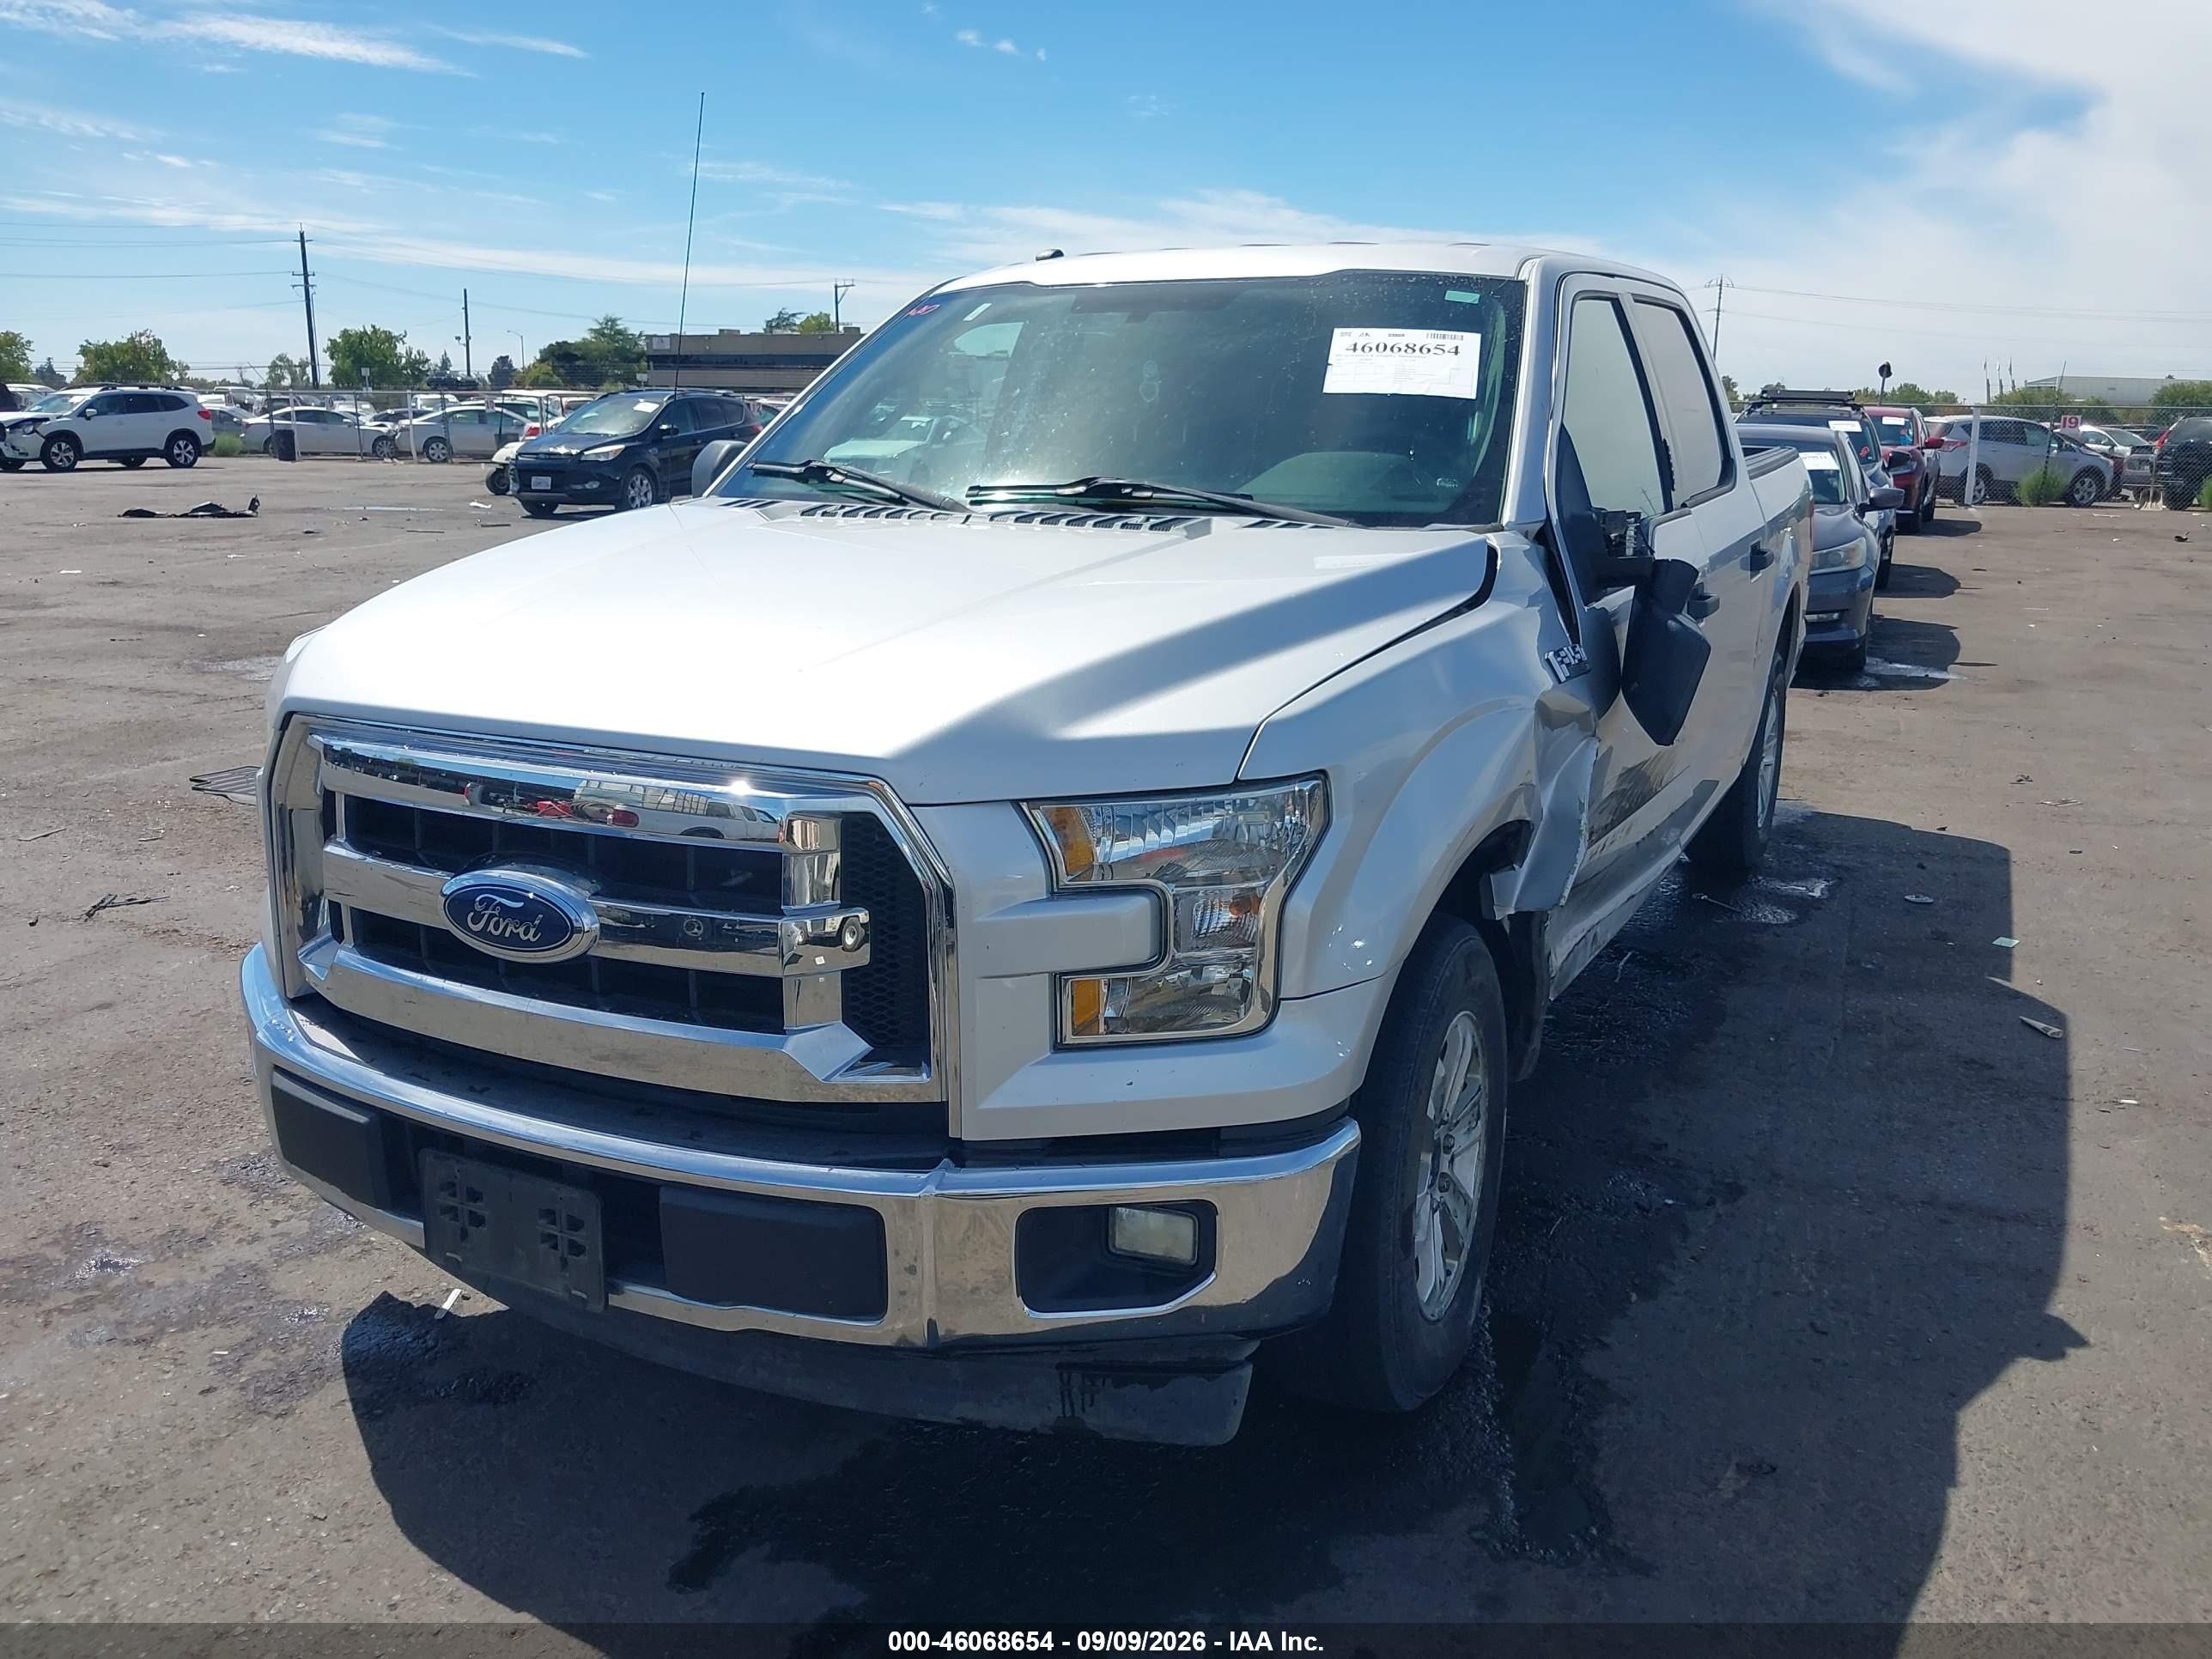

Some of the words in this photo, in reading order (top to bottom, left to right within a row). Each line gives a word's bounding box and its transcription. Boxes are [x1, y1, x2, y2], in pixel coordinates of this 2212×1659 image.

[1345, 342, 1461, 356] 46068654
[2063, 416, 2079, 428] 19
[467, 893, 544, 942] Ford
